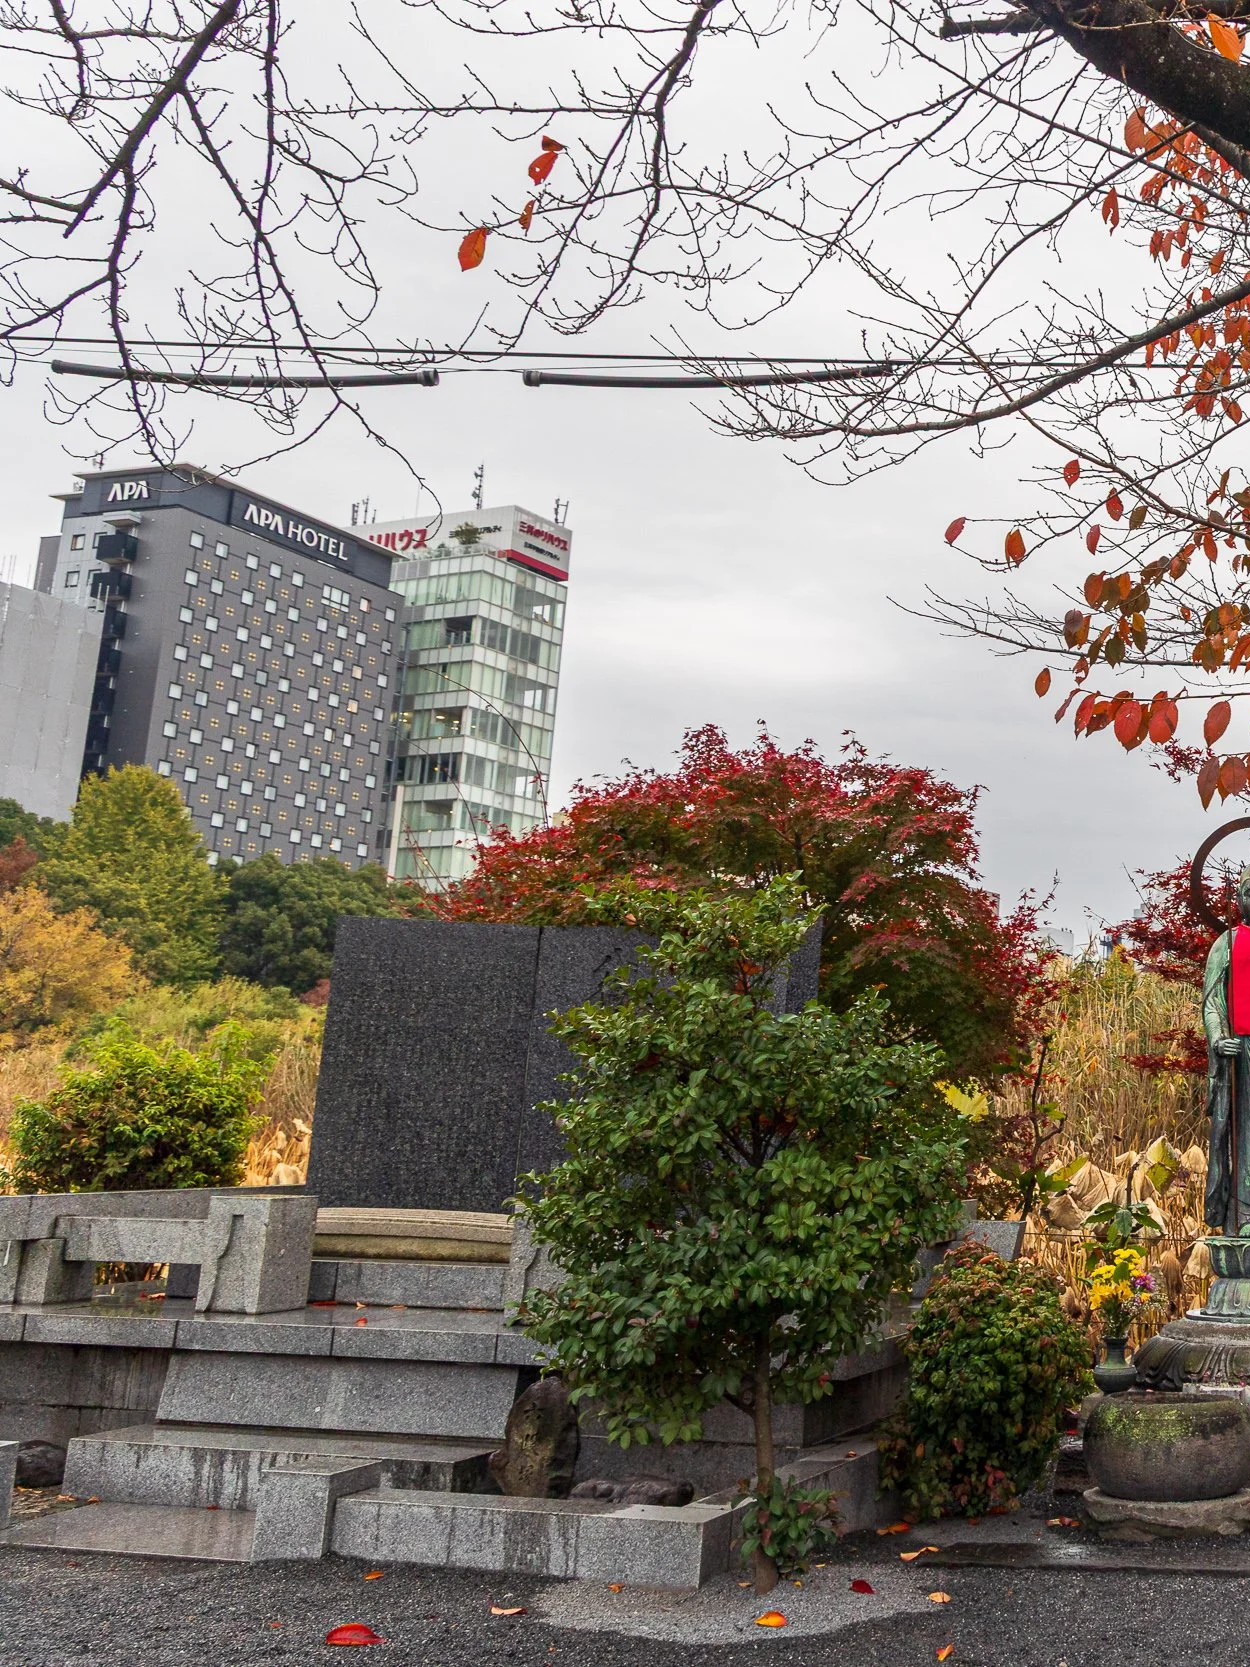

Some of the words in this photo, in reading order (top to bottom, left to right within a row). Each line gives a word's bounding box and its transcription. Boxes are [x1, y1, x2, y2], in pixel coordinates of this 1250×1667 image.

[107, 480, 150, 502] APA
[244, 503, 285, 535] APA
[287, 520, 349, 561] HOTEL
